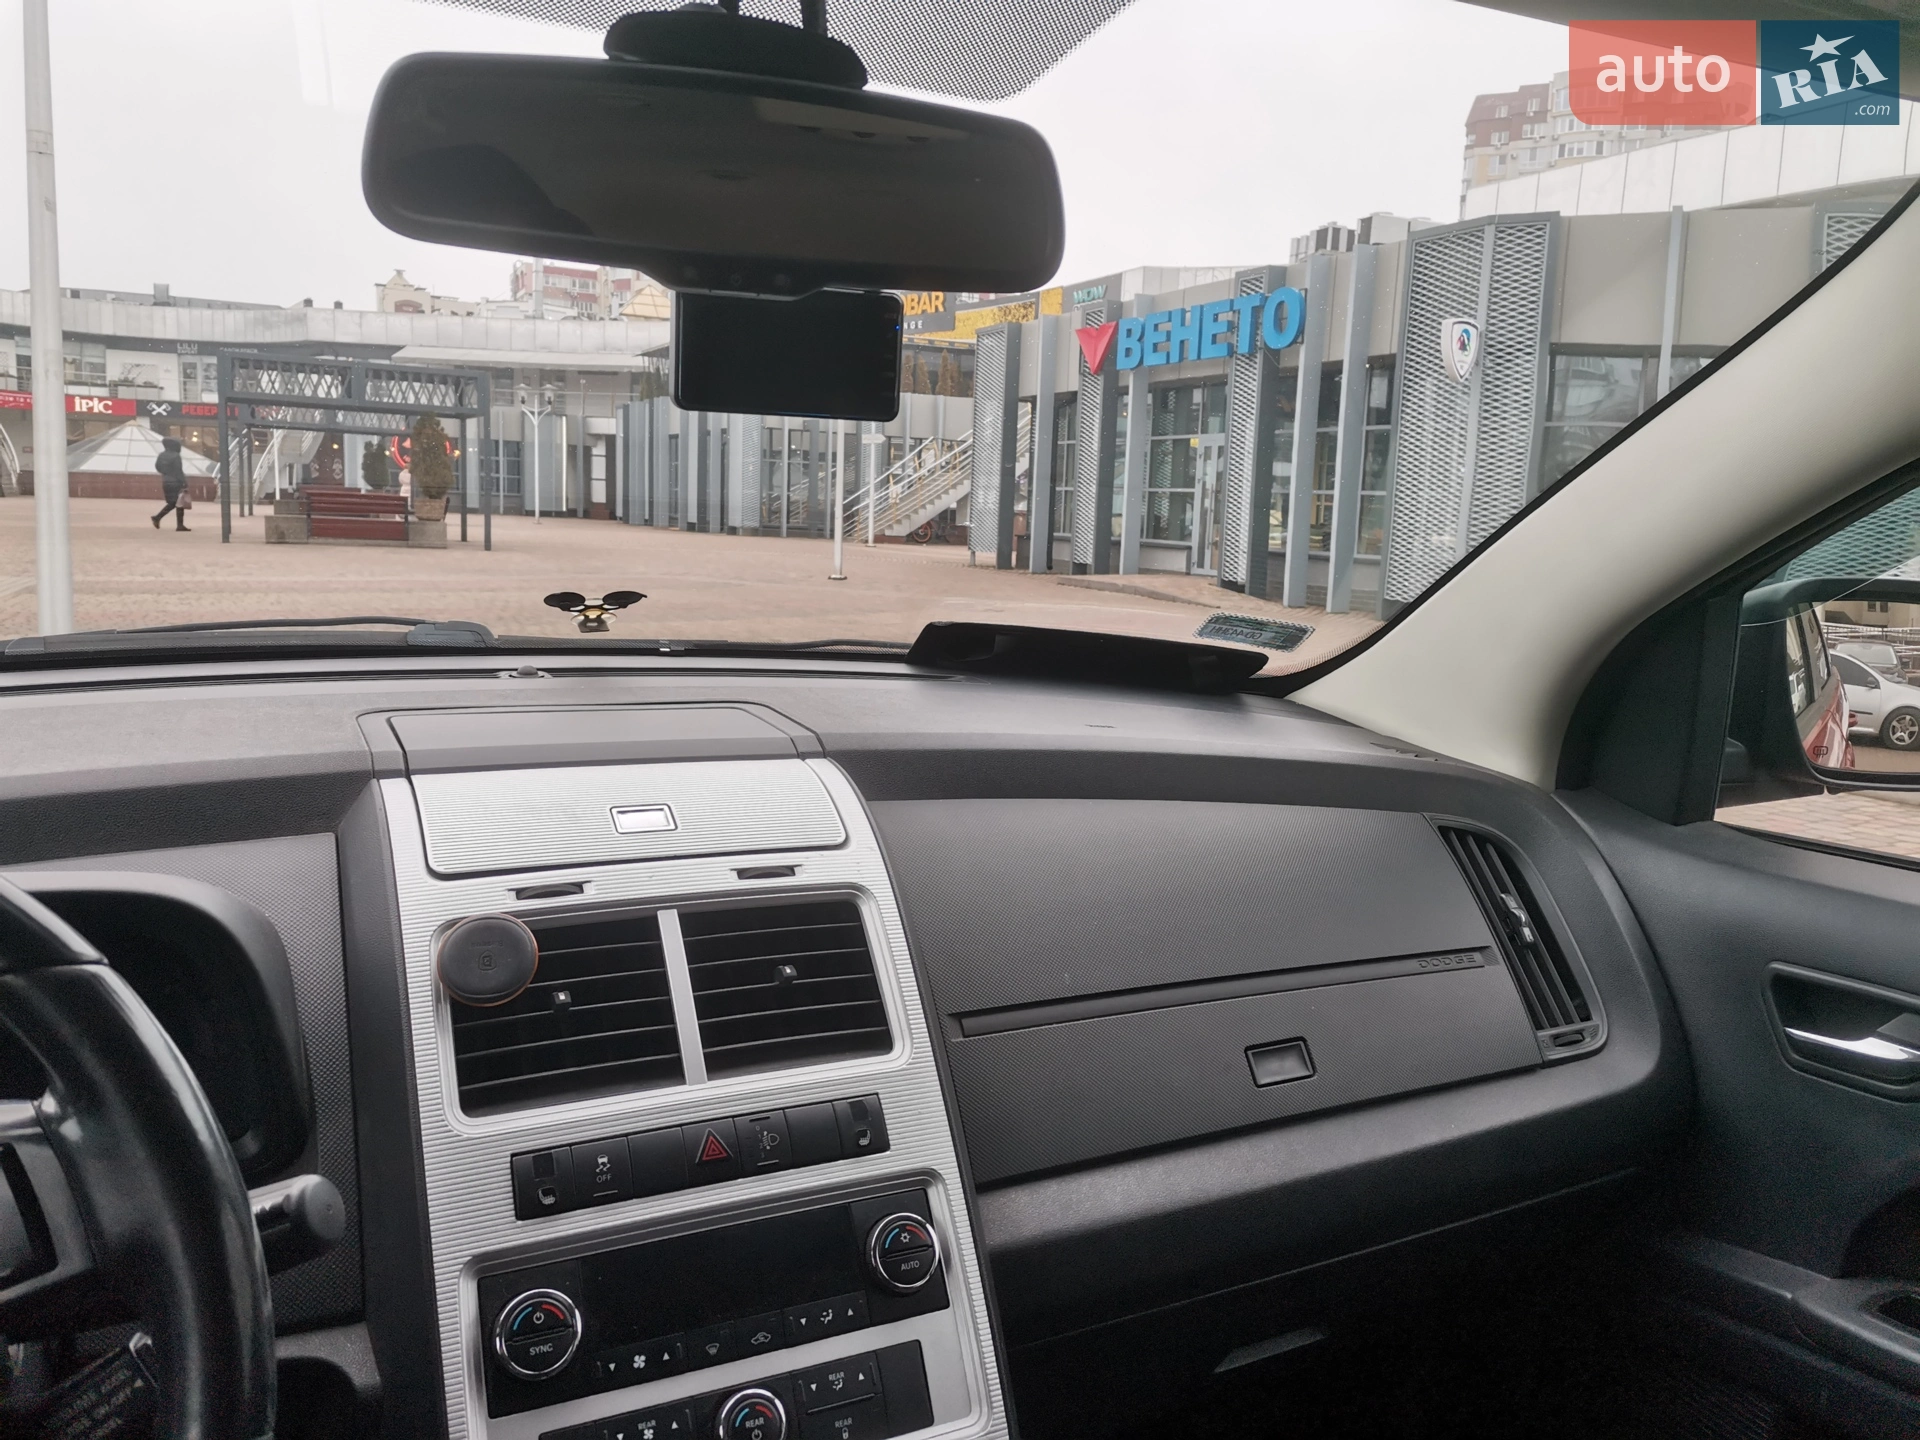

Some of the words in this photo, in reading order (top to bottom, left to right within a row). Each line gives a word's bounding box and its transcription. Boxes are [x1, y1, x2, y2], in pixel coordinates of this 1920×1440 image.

[1115, 286, 1306, 371] ВЕНЕТО
[1417, 954, 1477, 969] DODGE
[596, 1173, 612, 1183] OFF
[900, 1260, 920, 1271] AUTO
[529, 1343, 553, 1356] SYNC
[828, 1371, 845, 1381] REAR
[637, 1419, 657, 1430] REAR
[745, 1417, 765, 1428] REAR
[834, 1417, 853, 1428] REAR
